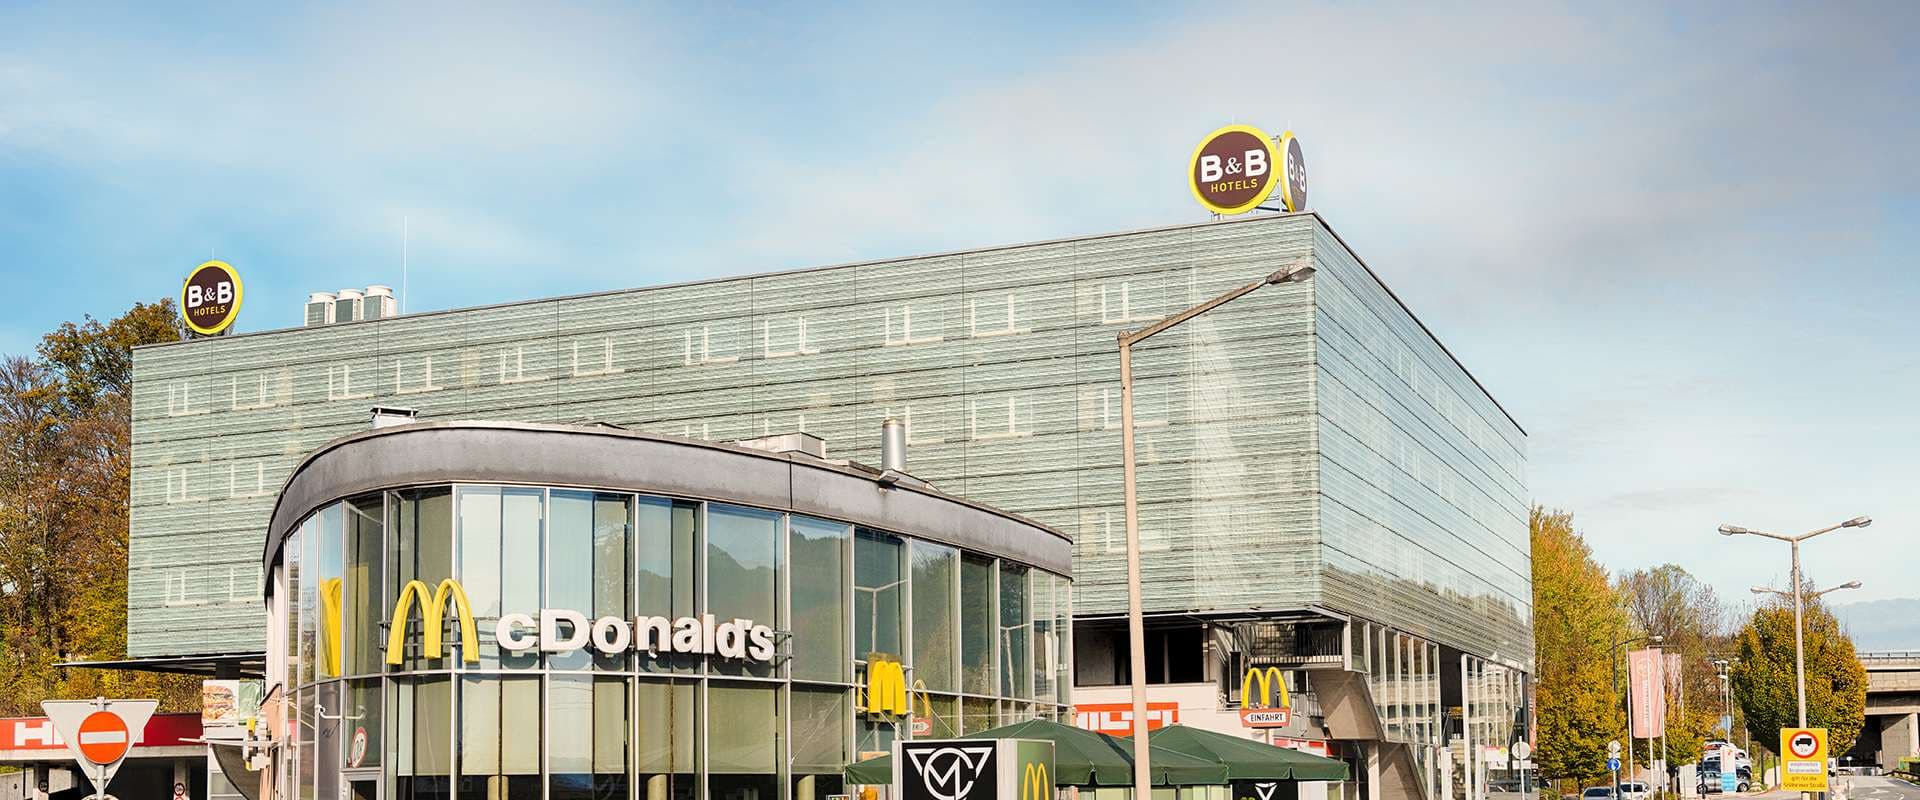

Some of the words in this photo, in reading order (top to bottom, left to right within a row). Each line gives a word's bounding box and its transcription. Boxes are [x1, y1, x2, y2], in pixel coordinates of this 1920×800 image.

[1201, 149, 1267, 182] B&B
[1211, 179, 1258, 193] HOTELS
[188, 281, 232, 308] B&B
[194, 305, 225, 316] HOTELS
[1250, 713, 1283, 722] EINFAHRT
